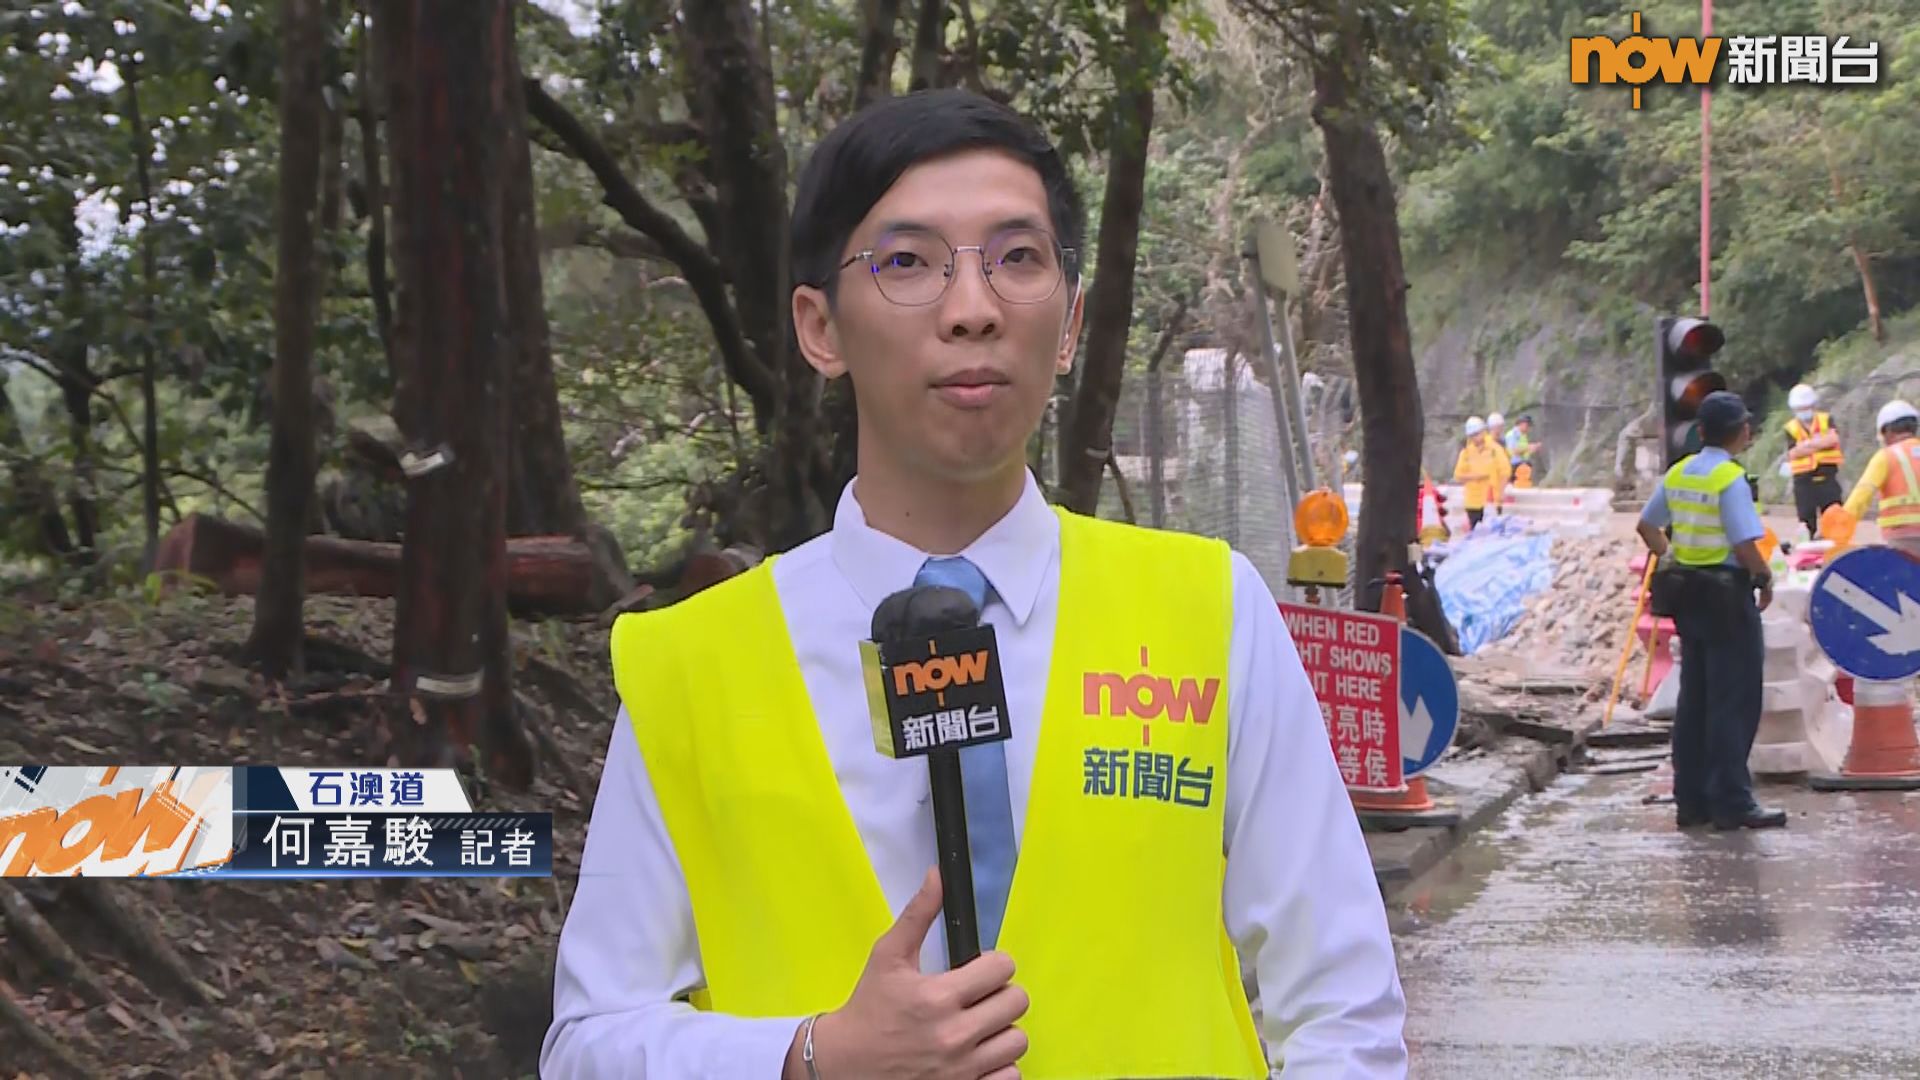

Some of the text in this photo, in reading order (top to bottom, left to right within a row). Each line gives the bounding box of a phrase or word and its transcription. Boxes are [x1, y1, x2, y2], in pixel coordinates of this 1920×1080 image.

[1284, 611, 1380, 646] WHEN RED
[892, 648, 990, 696] now
[1329, 645, 1392, 677] SHOWS
[1083, 672, 1221, 725] now
[1335, 673, 1382, 702] HERE
[901, 703, 1000, 752] 新聞台
[1082, 747, 1215, 808] 新聞台
